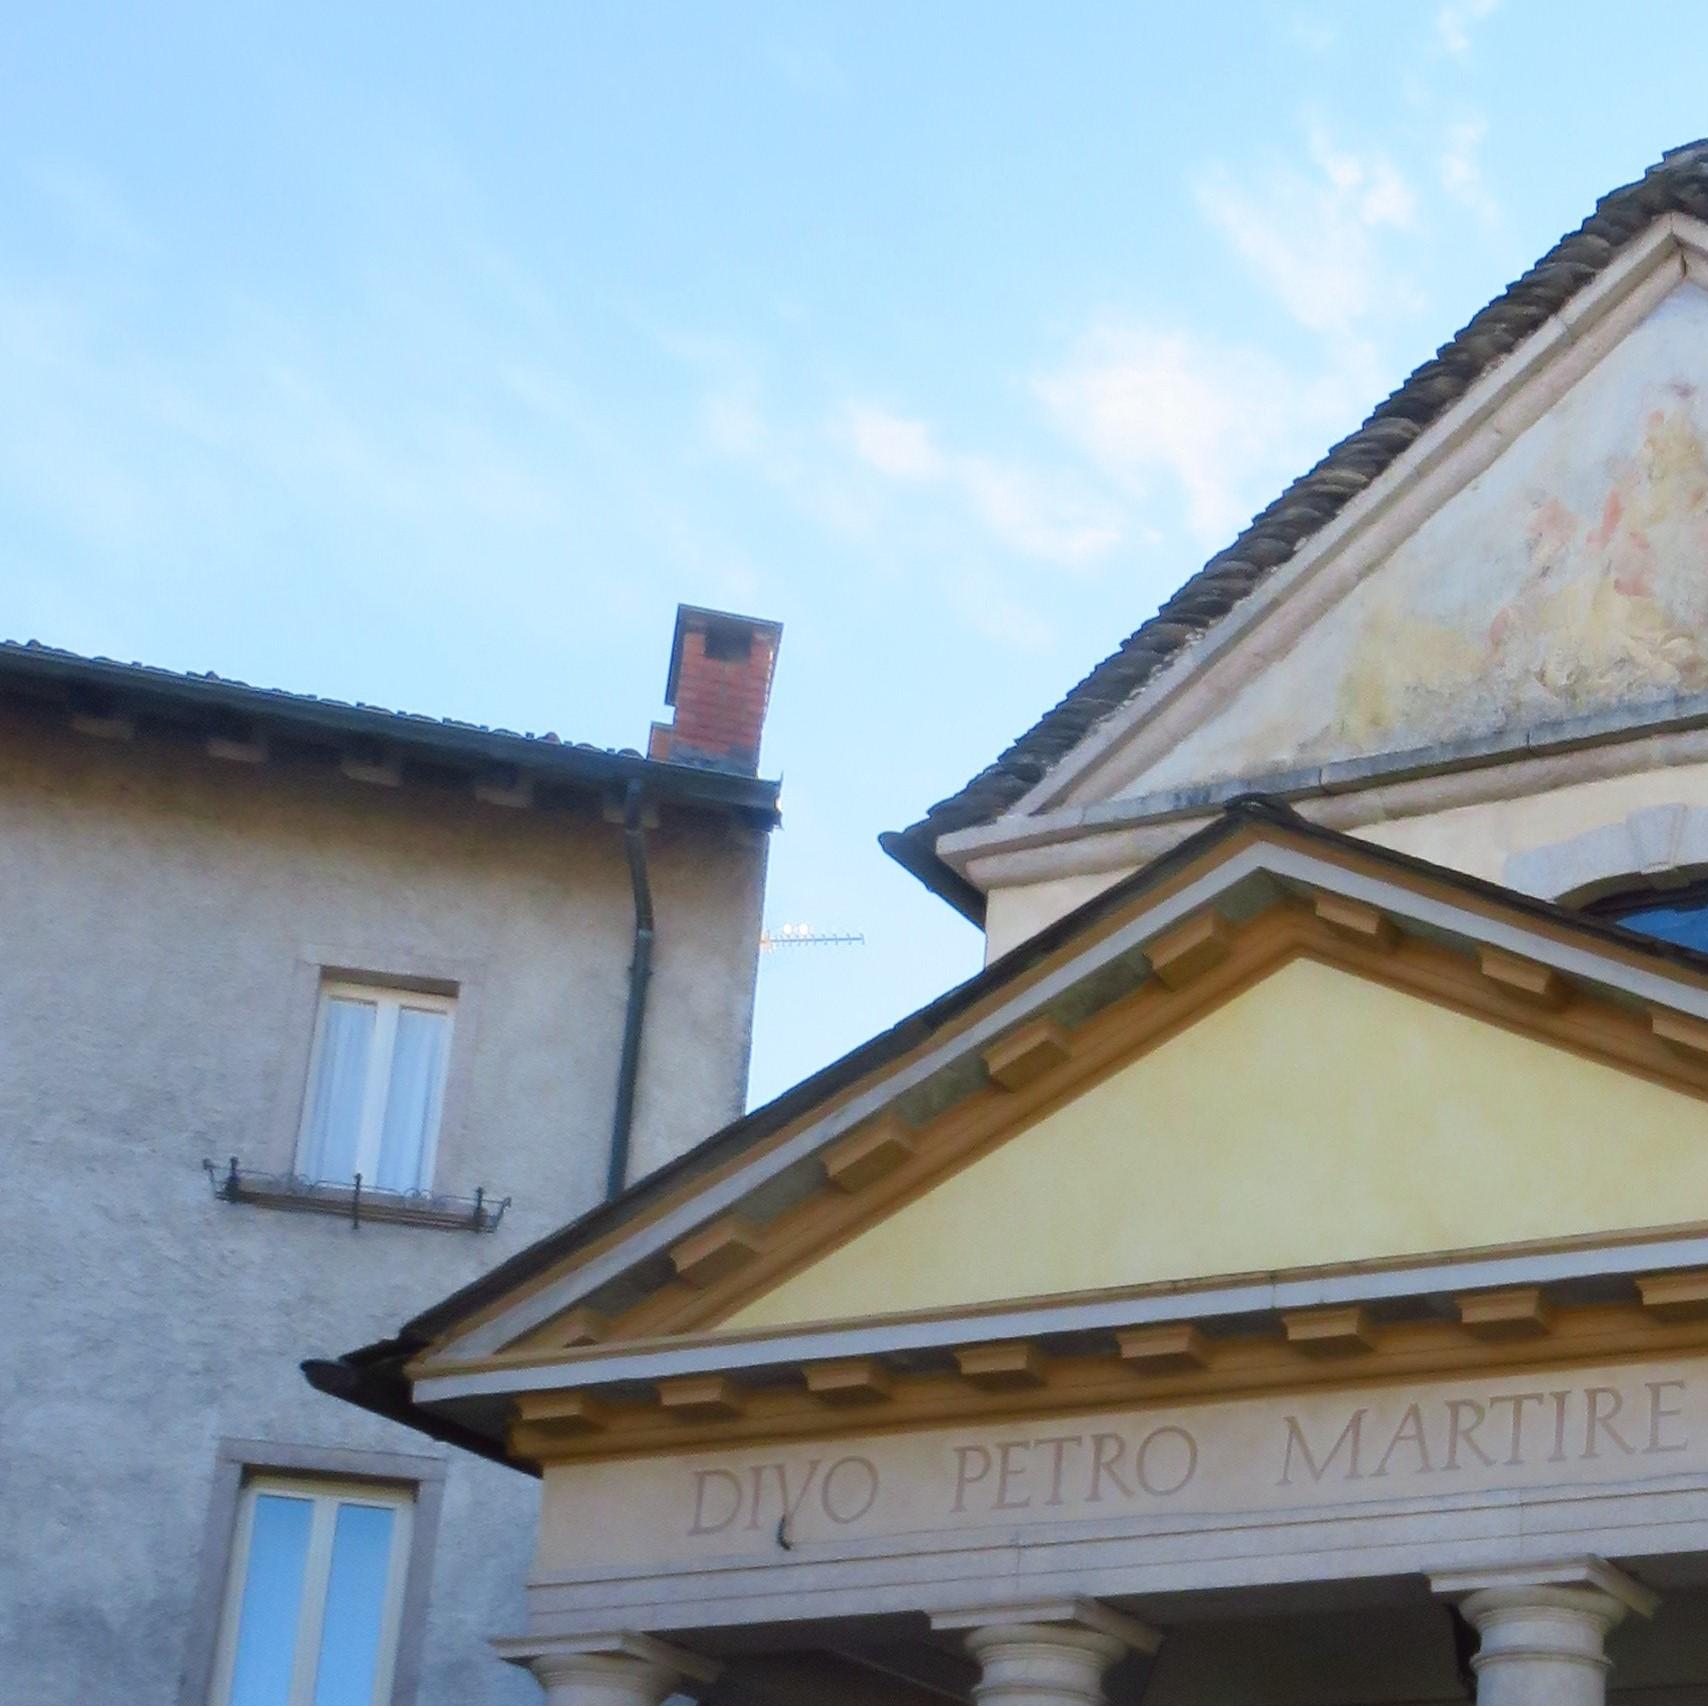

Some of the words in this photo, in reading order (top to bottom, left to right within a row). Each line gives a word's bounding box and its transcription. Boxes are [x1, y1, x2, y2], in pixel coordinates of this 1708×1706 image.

[687, 1455, 880, 1537] DIVO
[949, 1425, 1199, 1513] PETRO
[1275, 1379, 1689, 1487] MARTIRE
